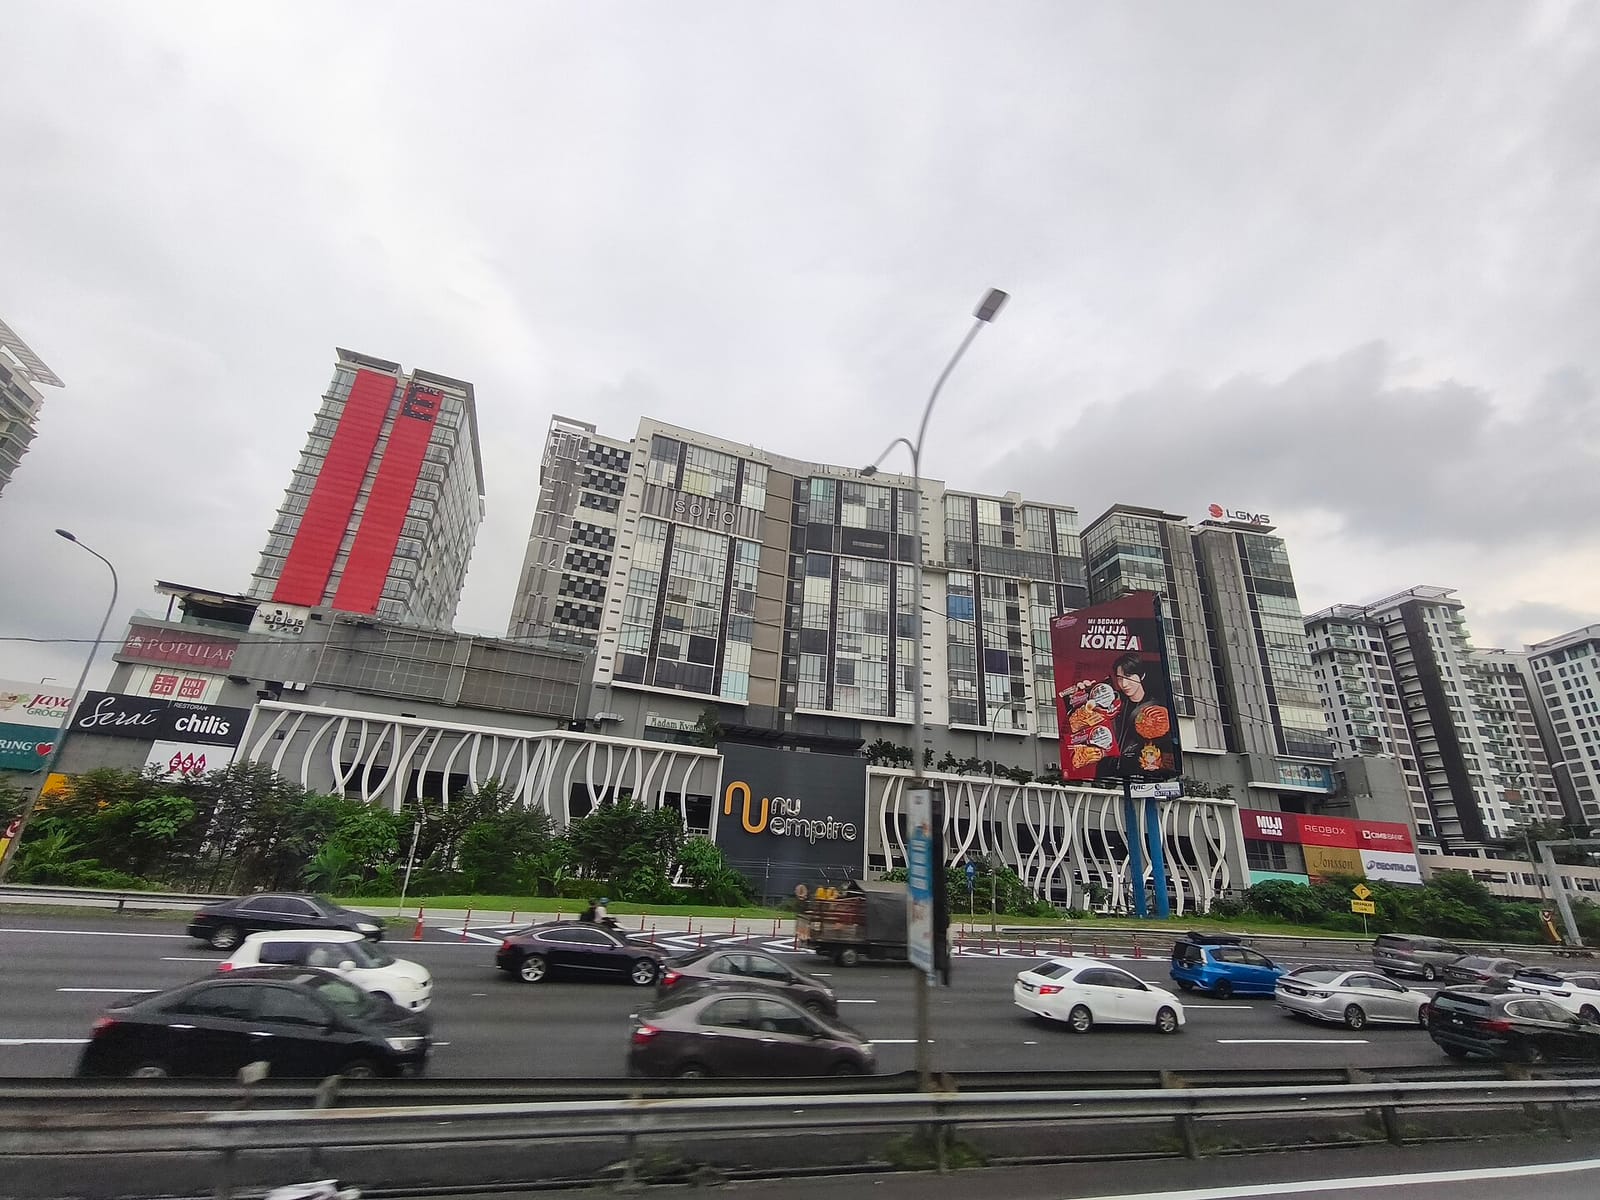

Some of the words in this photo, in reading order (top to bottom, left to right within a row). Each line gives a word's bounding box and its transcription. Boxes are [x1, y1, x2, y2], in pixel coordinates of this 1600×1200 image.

[674, 499, 736, 526] SOHO
[1225, 508, 1271, 524] LGMS
[1087, 625, 1128, 635] JINJJA
[146, 638, 236, 661] POPULAR
[1080, 634, 1140, 651] KOREA
[180, 687, 201, 696] QLO
[183, 680, 203, 689] UNI
[78, 696, 161, 728] Serai
[173, 702, 208, 711] RESTORAN
[170, 758, 205, 769] ESH
[770, 796, 801, 816] nu
[769, 815, 858, 845] empire
[1255, 815, 1283, 830] MUJI
[1304, 824, 1347, 835] REDBOX
[1375, 861, 1417, 873] DECATHLON
